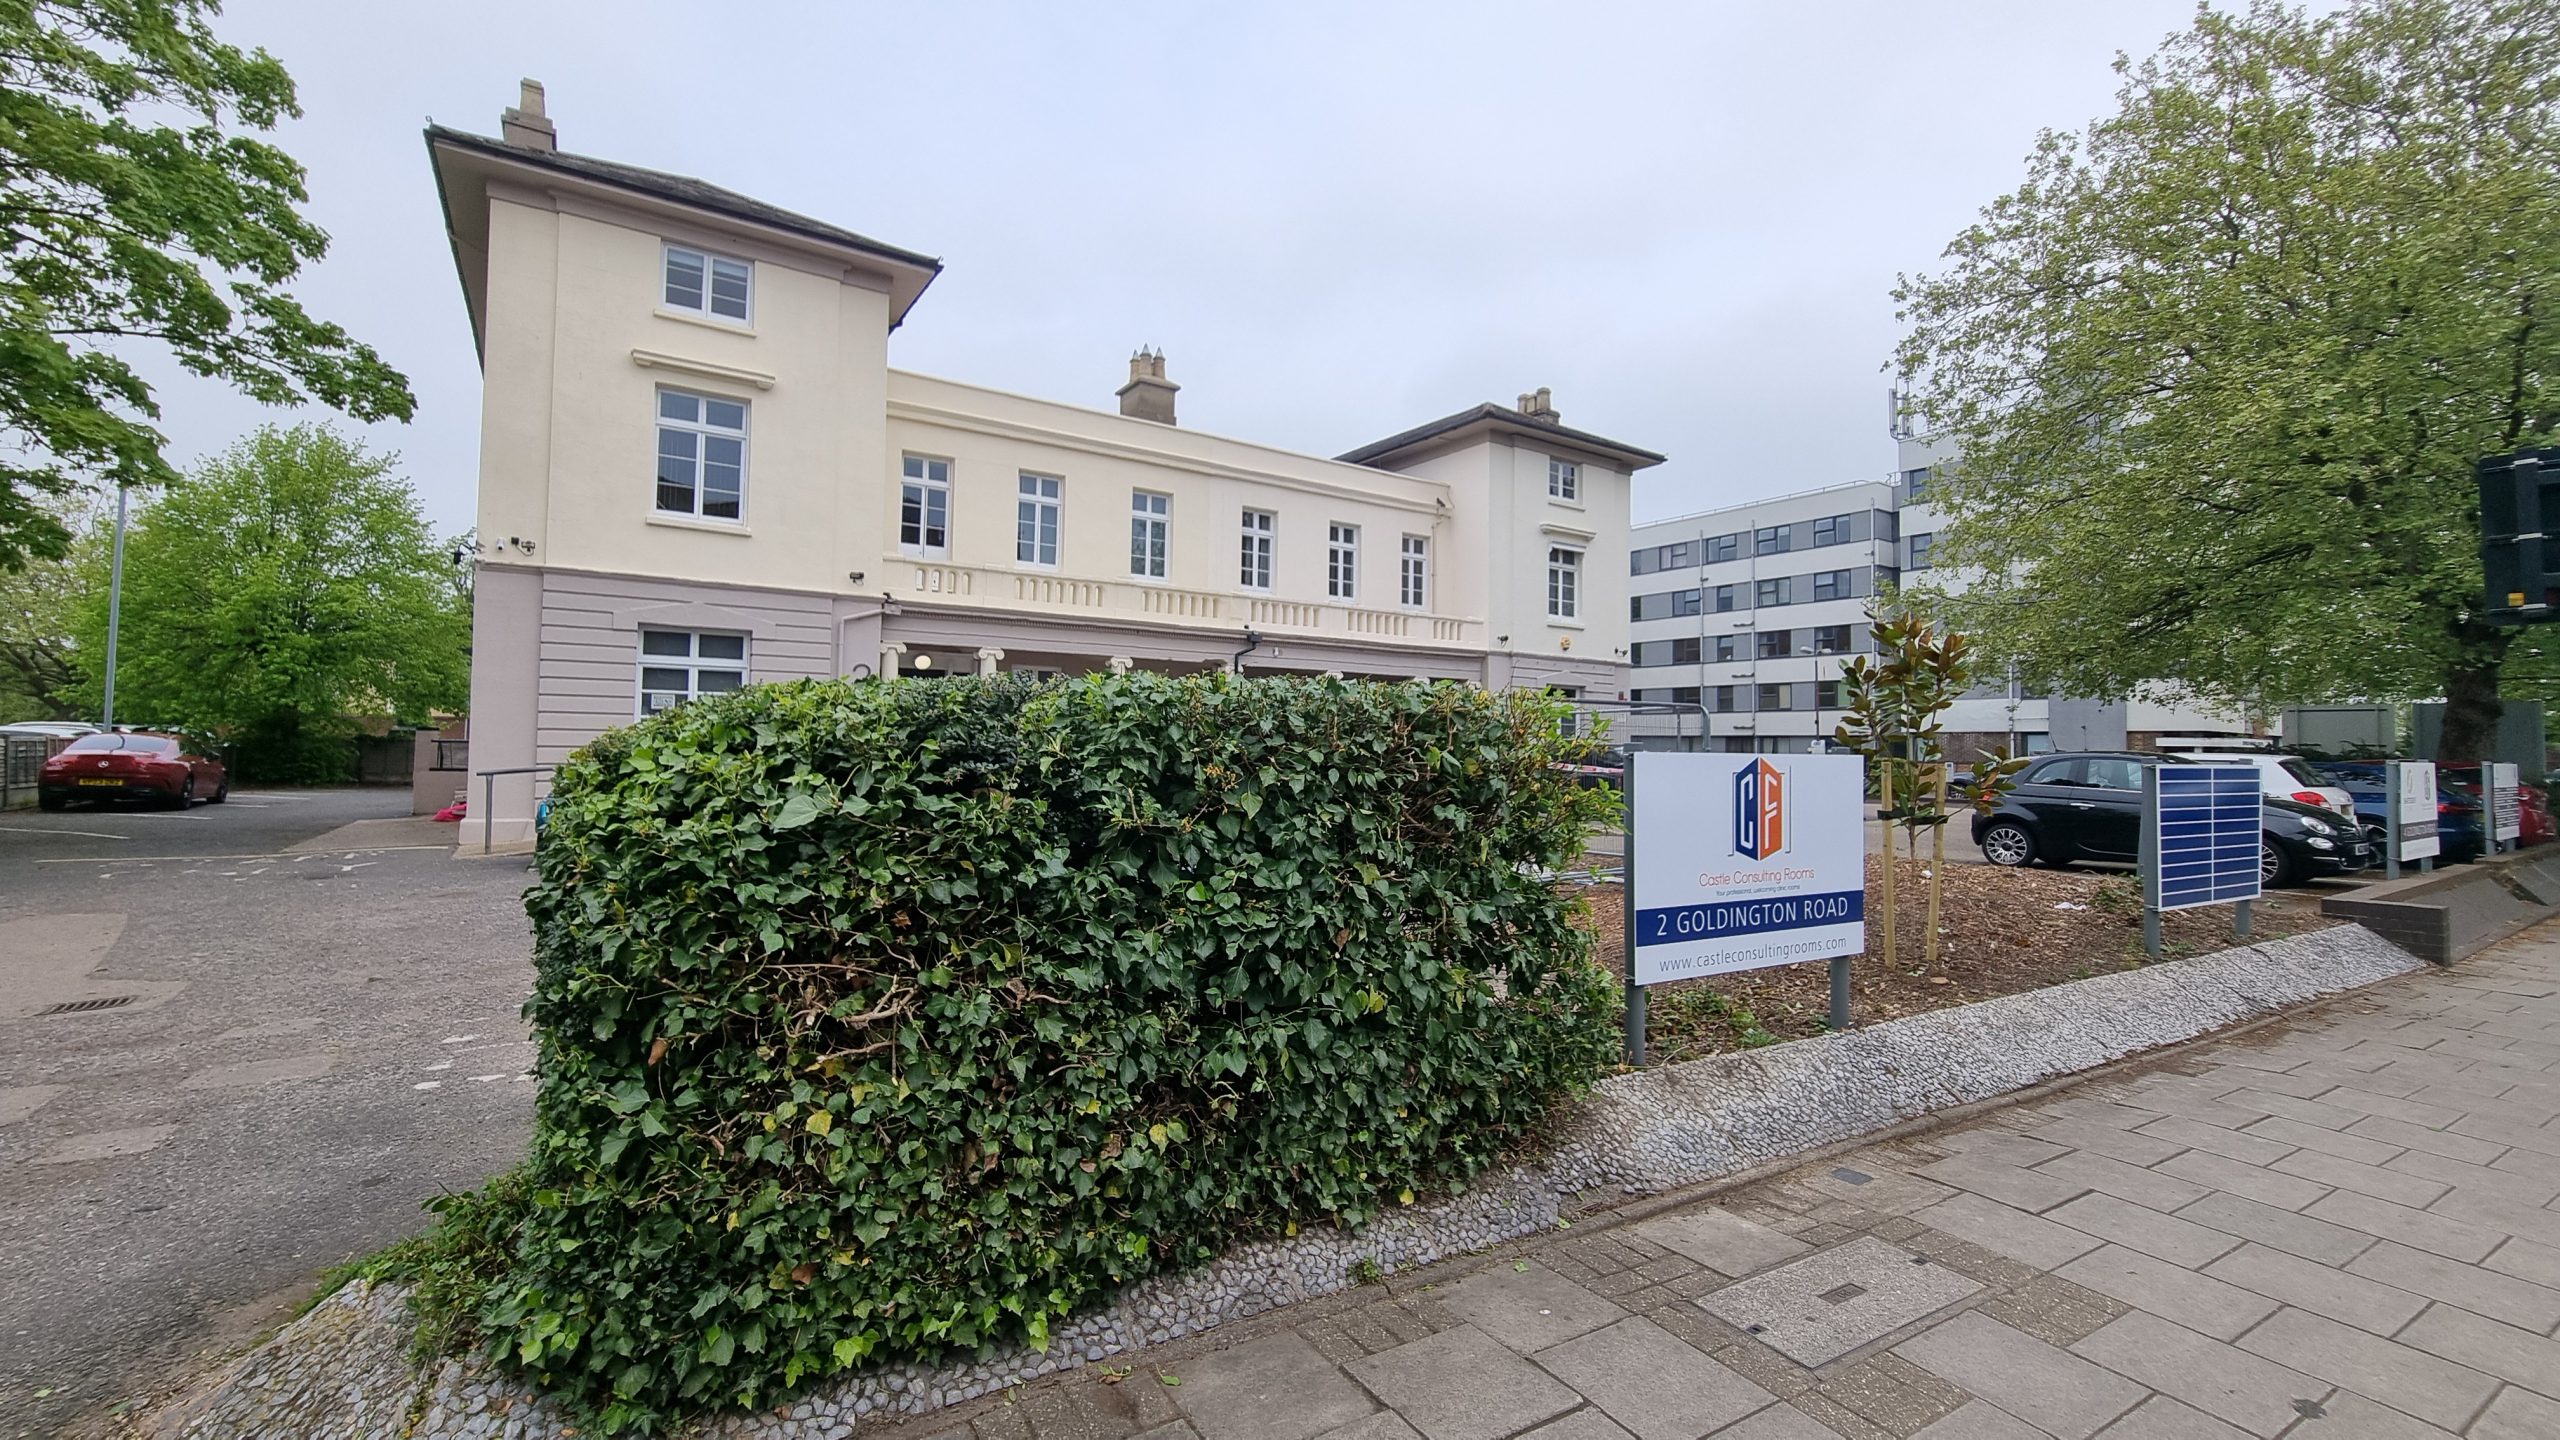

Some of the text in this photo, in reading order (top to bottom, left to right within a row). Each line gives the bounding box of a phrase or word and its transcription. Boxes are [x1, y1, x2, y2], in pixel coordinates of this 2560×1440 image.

[1699, 867, 1815, 887] Castle Consulting Rooms
[1656, 896, 1849, 937] 2 GOLDINGTON ROAD
[1659, 935, 1847, 973] www.castleconsultingrooms.com
